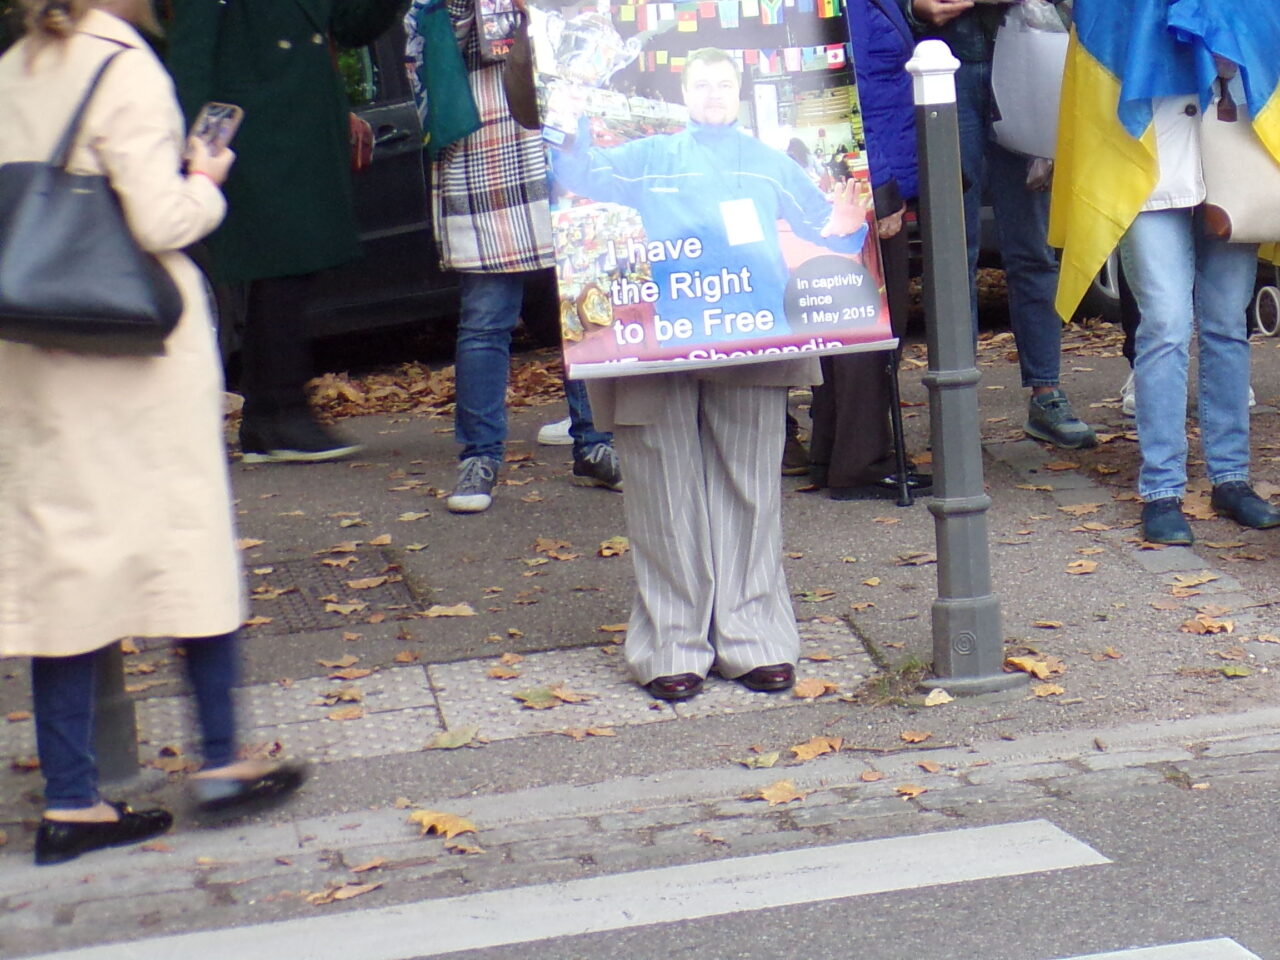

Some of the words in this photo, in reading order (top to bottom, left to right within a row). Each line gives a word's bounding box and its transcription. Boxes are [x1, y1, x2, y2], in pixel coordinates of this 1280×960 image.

[607, 240, 617, 266] I
[627, 236, 703, 264] have
[610, 277, 661, 306] the
[669, 266, 753, 303] Right
[812, 273, 864, 289] captivity
[799, 295, 833, 307] since
[613, 319, 645, 345] to
[653, 315, 694, 341] be
[703, 308, 775, 336] Free
[801, 312, 808, 324] 1
[812, 310, 840, 324] May
[842, 305, 875, 321] 2015
